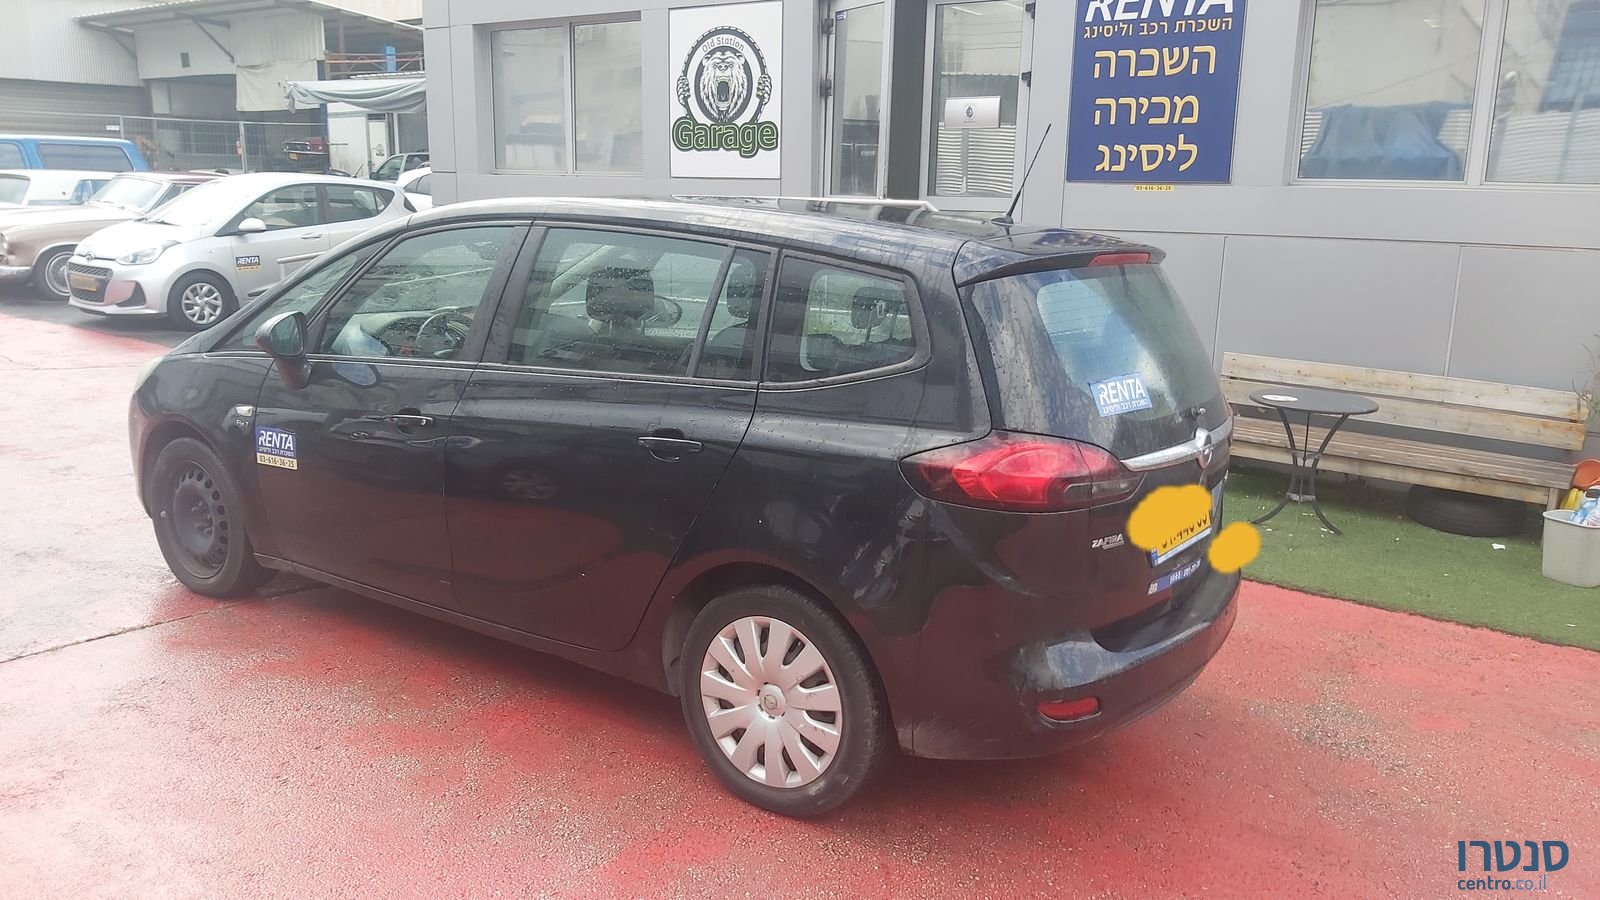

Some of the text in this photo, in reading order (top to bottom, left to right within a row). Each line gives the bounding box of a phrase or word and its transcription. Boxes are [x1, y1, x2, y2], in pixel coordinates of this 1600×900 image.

[1083, 17, 1233, 39] השכרת רכב וליסינג
[702, 36, 745, 53] Old Station
[1093, 45, 1216, 79] השכרה
[1094, 95, 1199, 125] מכירה
[673, 117, 778, 158] Garage
[1094, 133, 1198, 172] ליסינג
[238, 257, 258, 265] RENTA
[1097, 377, 1146, 406] RENTA
[259, 430, 293, 451] RENTA
[1091, 533, 1124, 548] ZAFIRA
